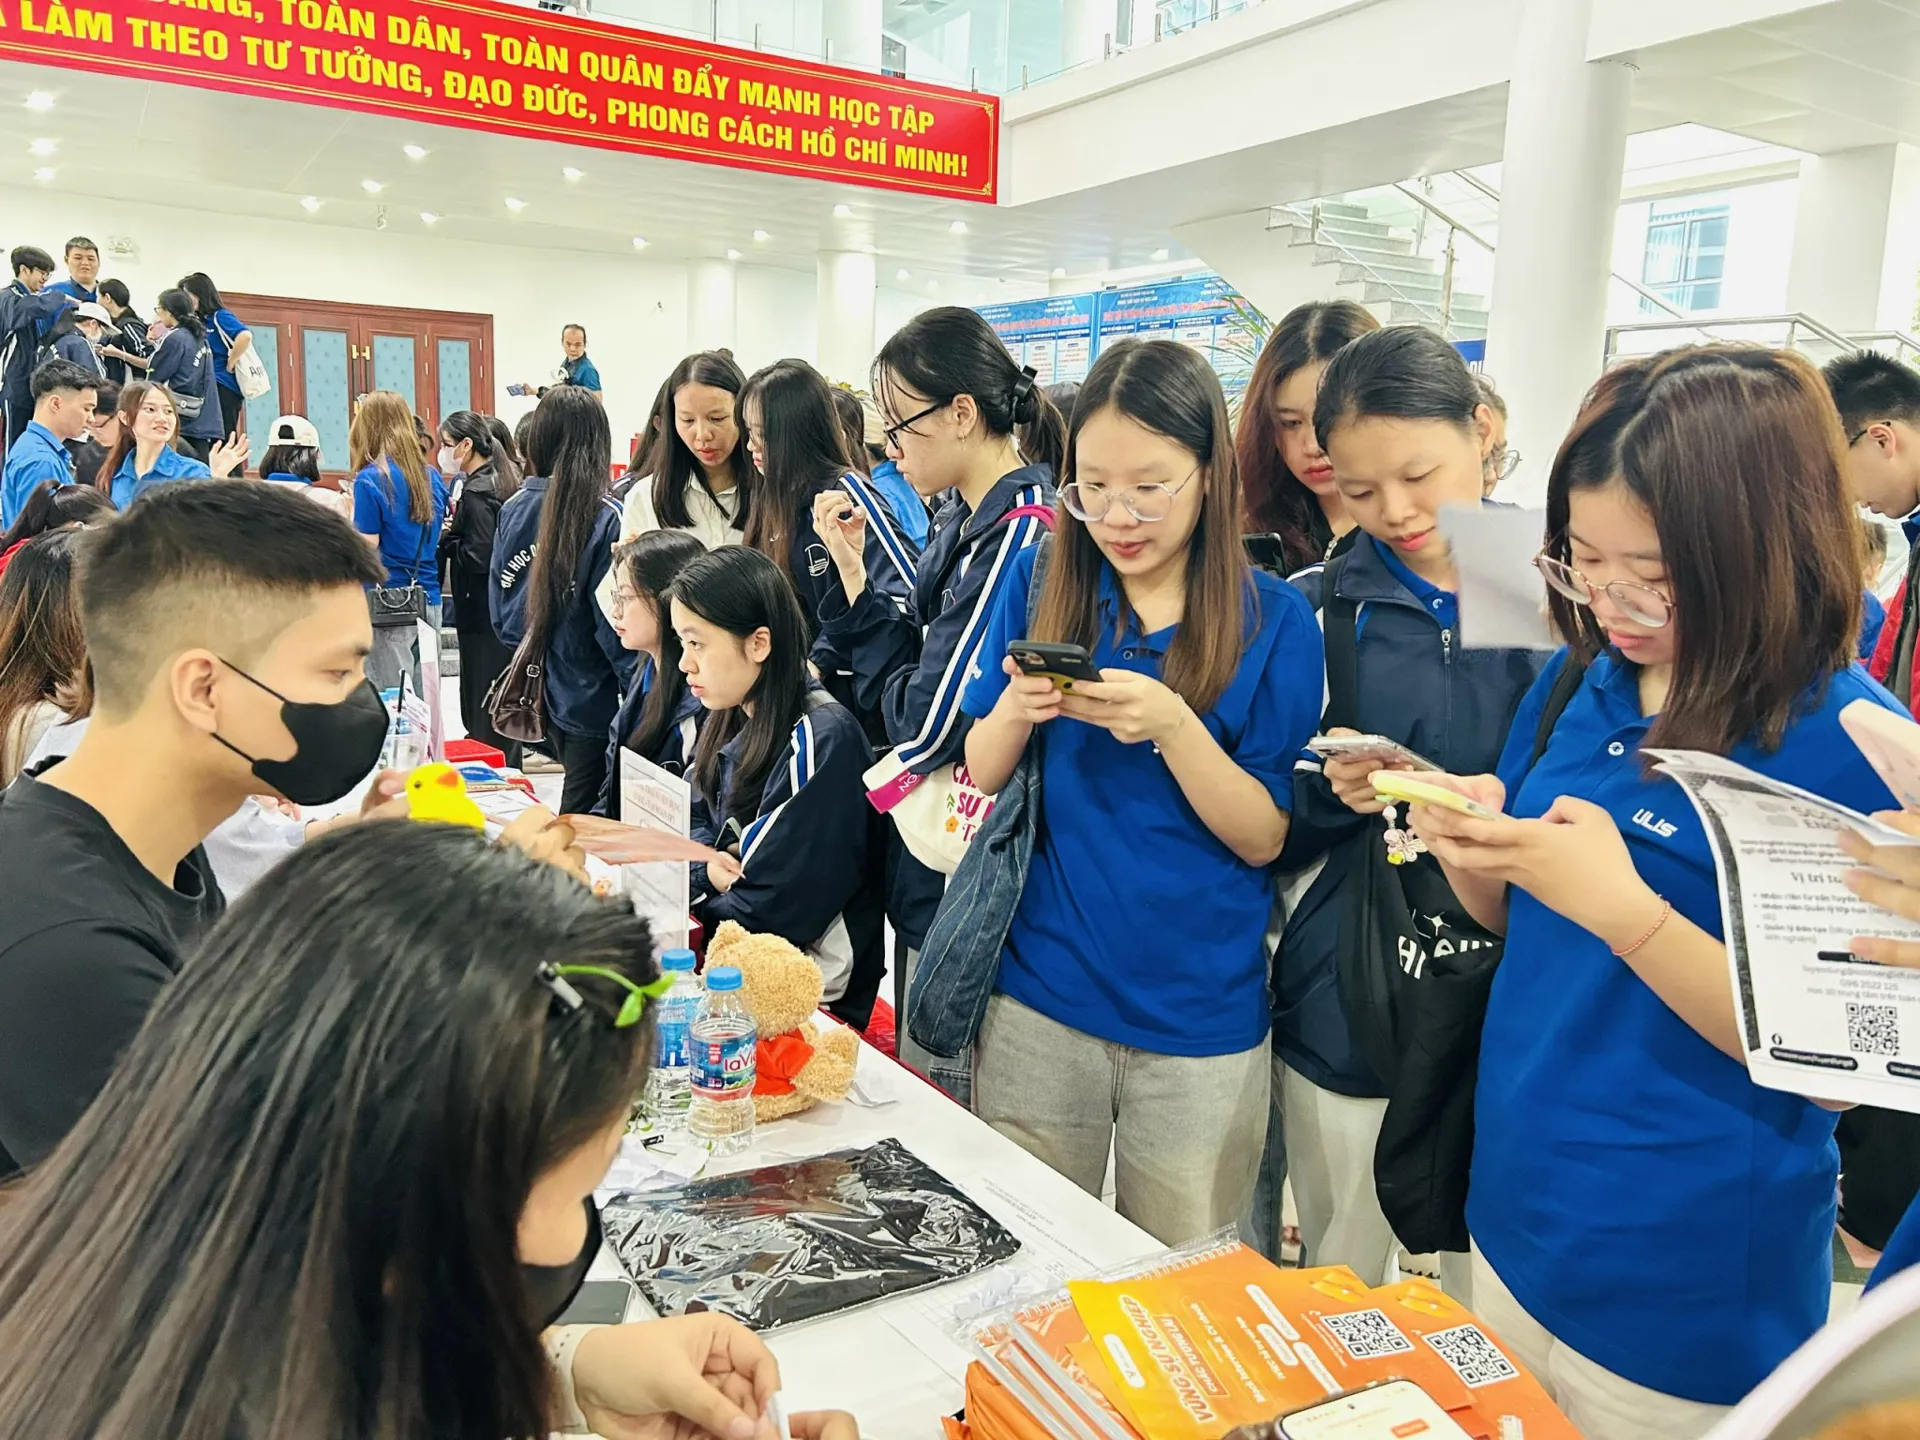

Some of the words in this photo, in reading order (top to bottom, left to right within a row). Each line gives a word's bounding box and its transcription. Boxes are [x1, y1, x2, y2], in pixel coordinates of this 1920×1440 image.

[276, 0, 376, 40] TOÀN
[387, 15, 472, 60] DÂN,
[481, 33, 569, 74] TOÀN
[579, 51, 664, 91] QUÂN
[672, 63, 730, 101] ĐẨY
[738, 79, 821, 117] MẠNH
[829, 95, 881, 128] HỌC
[888, 104, 935, 137] TẬP
[20, 0, 113, 43] LÀM
[125, 16, 229, 61] THEO
[240, 35, 292, 71] TƯ
[300, 45, 433, 98] TƯỞNG,
[443, 69, 513, 109] ĐẠO
[522, 83, 598, 125] ĐỨC,
[607, 97, 710, 139] PHONG
[718, 115, 793, 151] CÁCH
[801, 125, 837, 158] HỒ
[844, 138, 887, 165] CHÍ
[895, 144, 968, 177] MINH!
[507, 549, 531, 572] HỌC
[500, 569, 516, 589] ĐẠI
[1631, 808, 1679, 837] ULIS
[1827, 873, 1843, 884] tu
